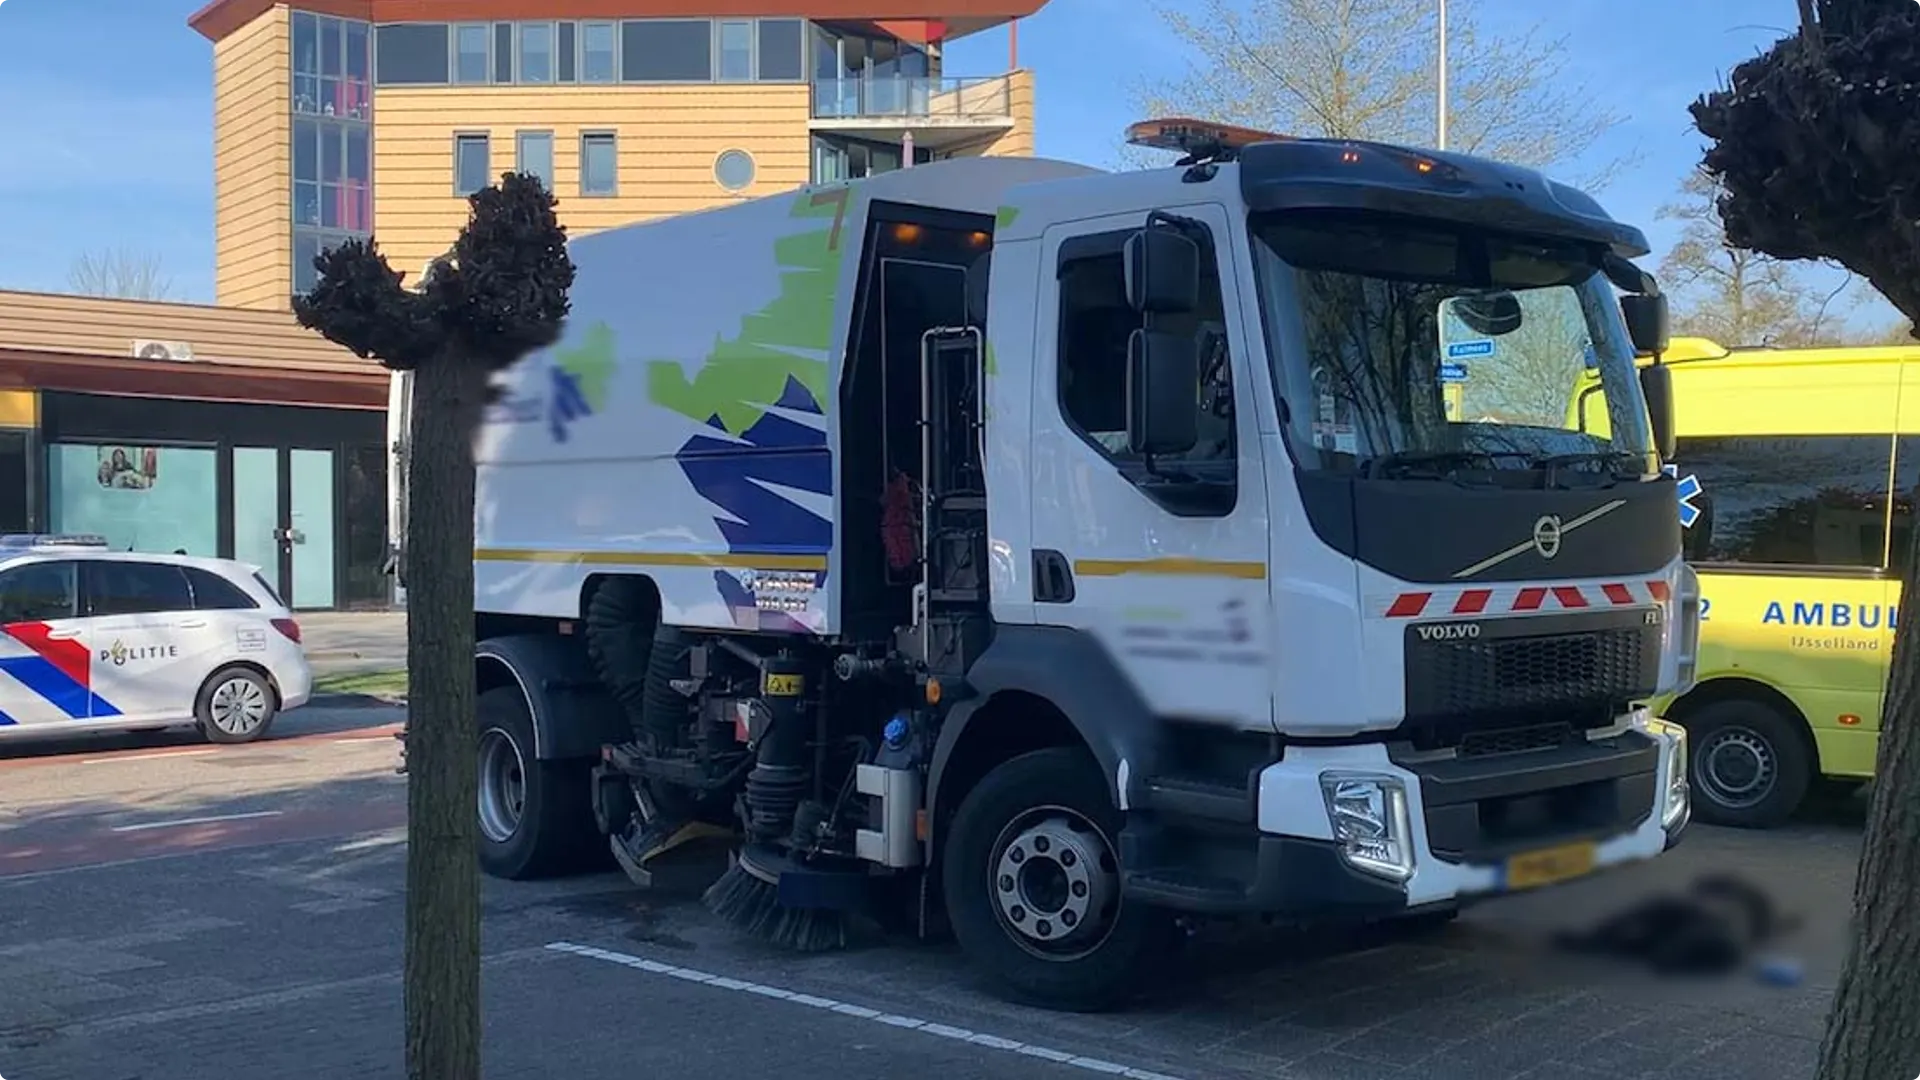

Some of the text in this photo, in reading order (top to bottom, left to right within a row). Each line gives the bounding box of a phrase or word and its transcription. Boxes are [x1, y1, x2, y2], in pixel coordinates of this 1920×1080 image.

[1417, 623, 1480, 641] VOLVO
[1791, 635, 1879, 651] IJsselland
[100, 643, 179, 667] POLITIE
